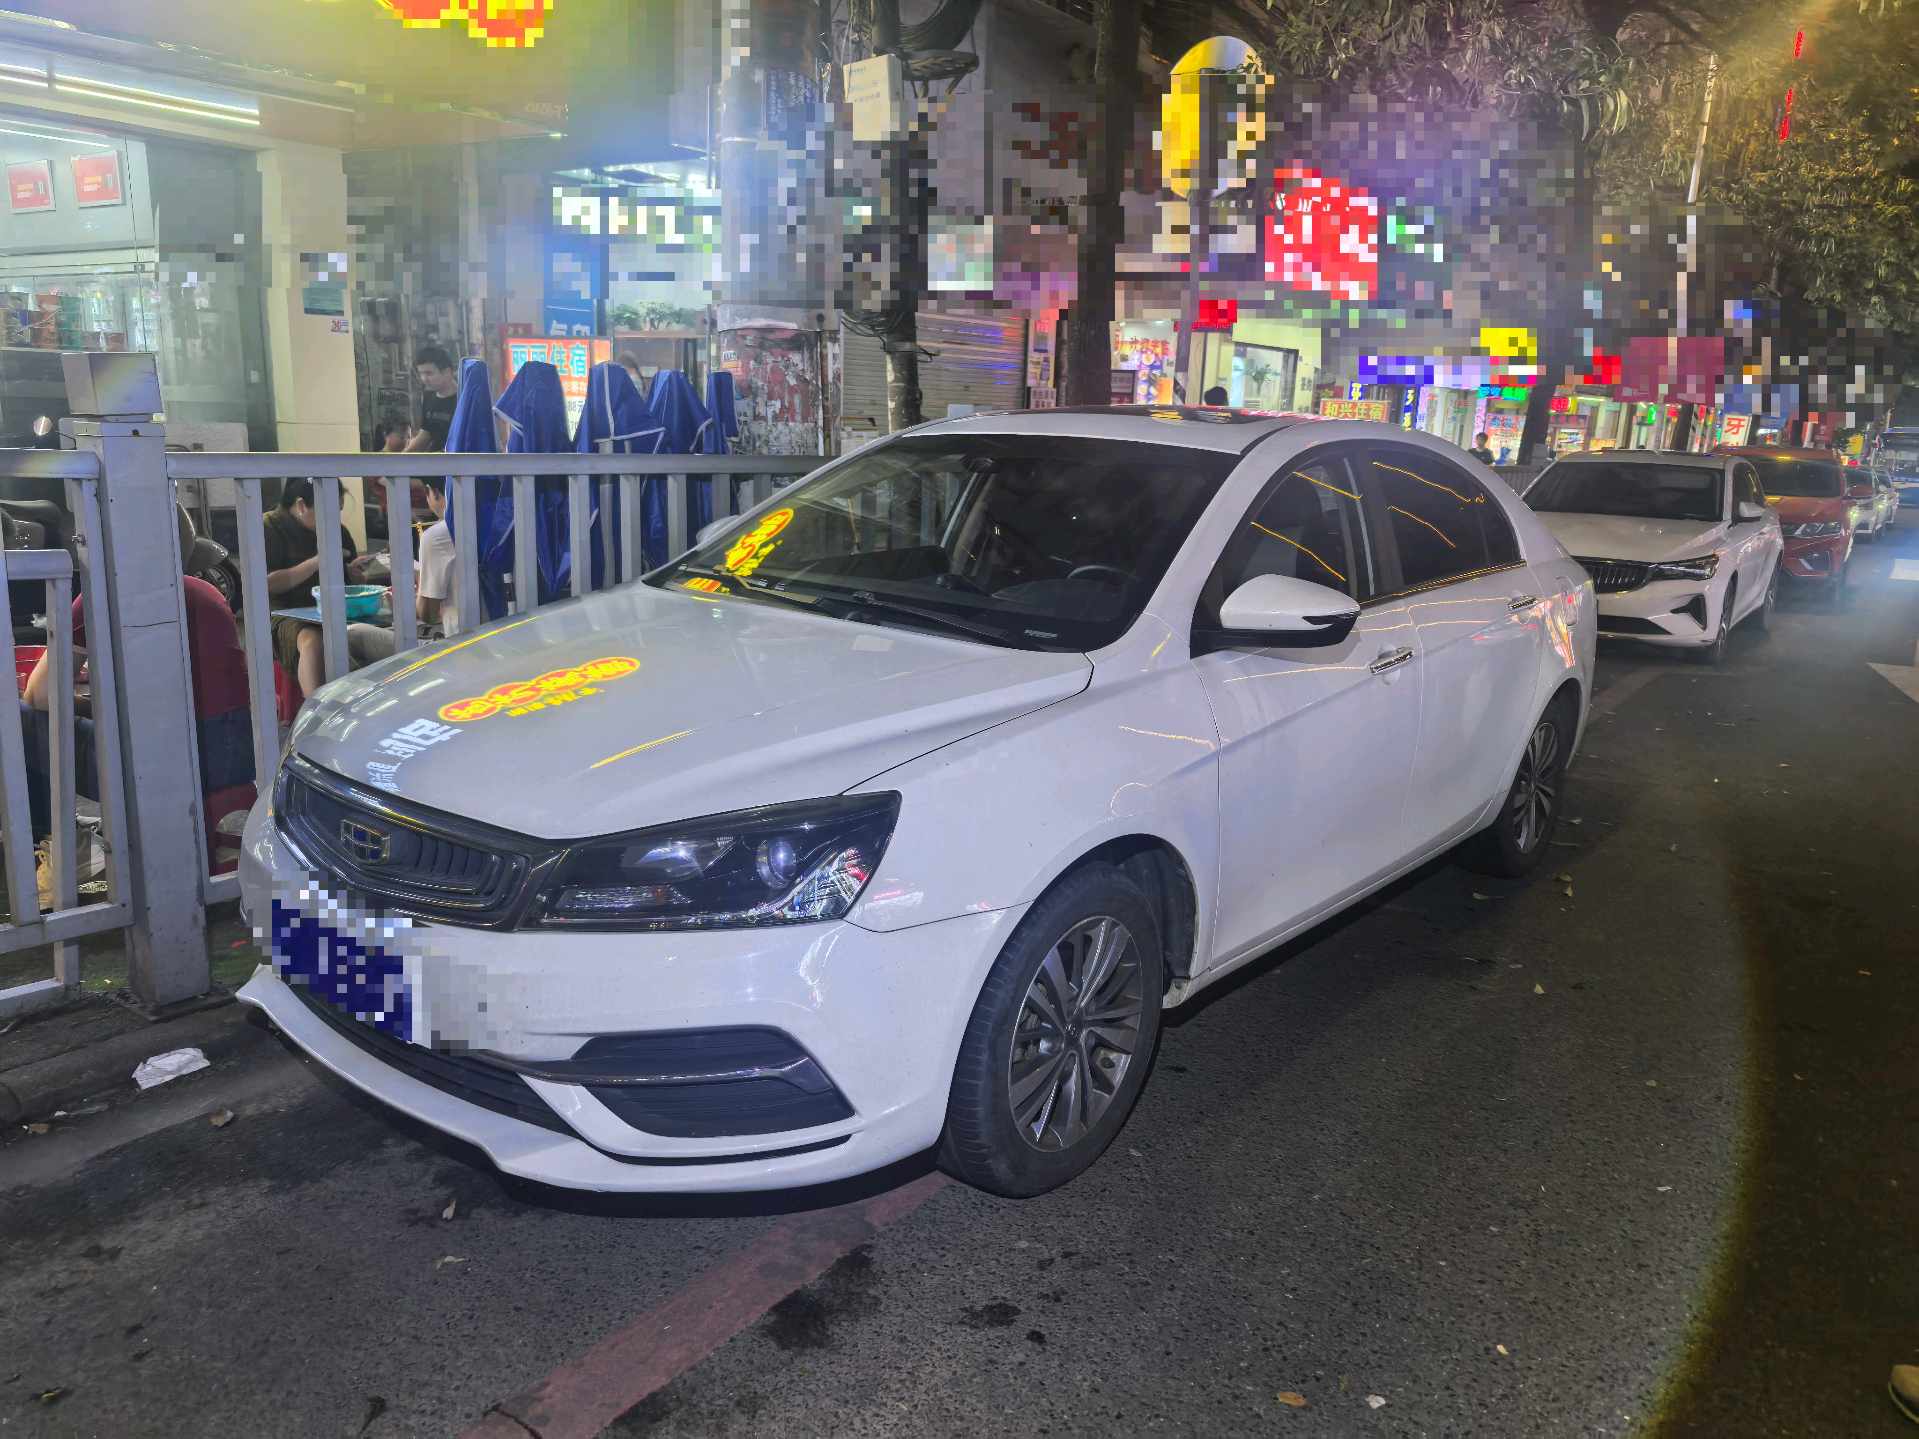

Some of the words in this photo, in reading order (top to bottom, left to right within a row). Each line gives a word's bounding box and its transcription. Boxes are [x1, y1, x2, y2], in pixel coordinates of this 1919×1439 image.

[1325, 401, 1383, 418] 和兴住宿
[1725, 417, 1744, 435] 牙
